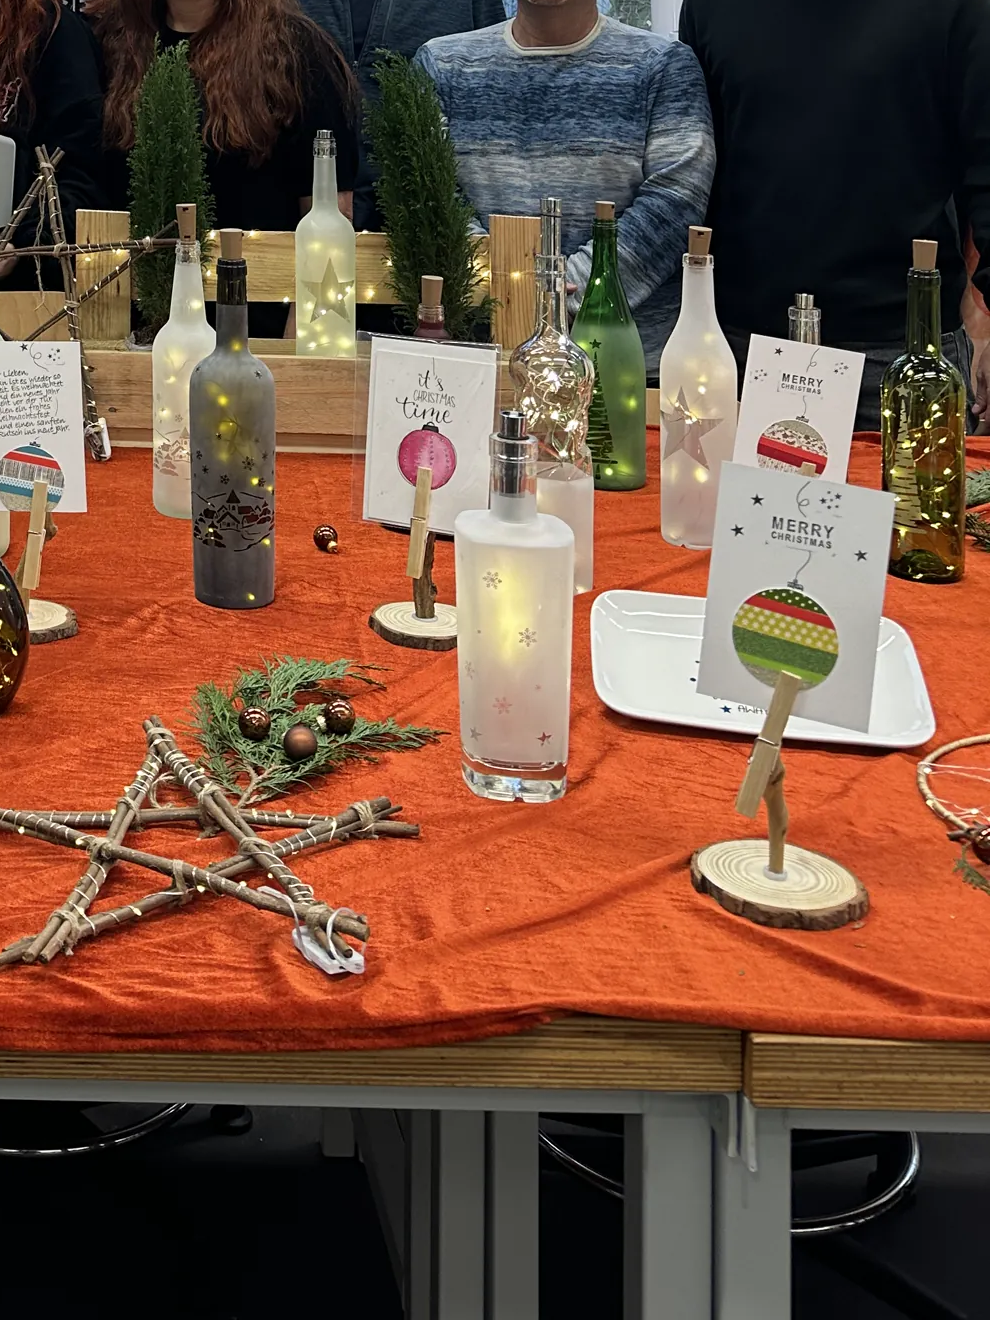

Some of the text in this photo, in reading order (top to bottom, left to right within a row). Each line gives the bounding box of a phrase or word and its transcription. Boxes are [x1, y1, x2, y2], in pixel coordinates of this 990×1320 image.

[418, 370, 443, 391] it's
[781, 372, 824, 388] MERRY
[781, 383, 821, 395] CHRISTMAS
[413, 389, 456, 408] CHRISTMAS
[395, 397, 453, 424] time
[772, 516, 834, 539] MERRY
[770, 531, 832, 549] CHRISTMAS
[738, 704, 768, 715] AWA
